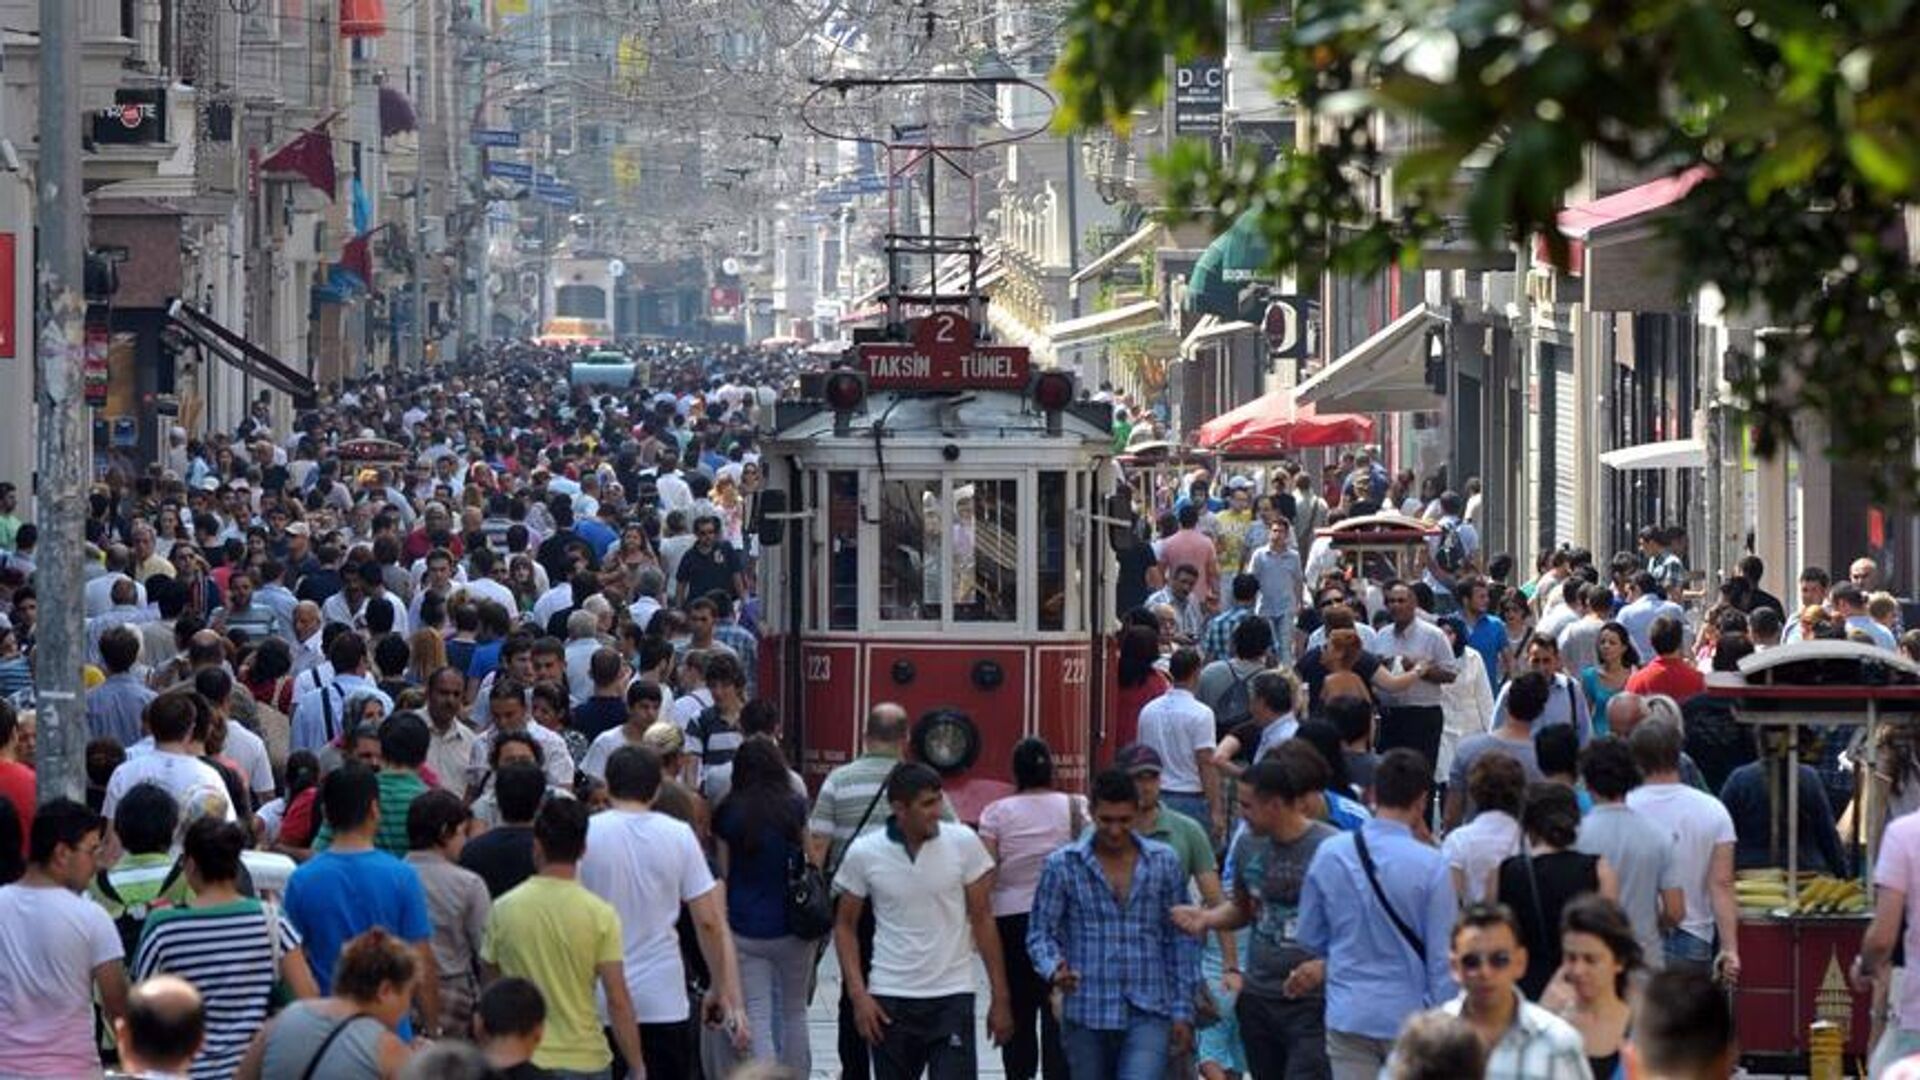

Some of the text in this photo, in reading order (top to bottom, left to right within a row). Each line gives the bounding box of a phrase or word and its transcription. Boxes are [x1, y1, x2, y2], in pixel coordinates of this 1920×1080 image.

[936, 315, 955, 342] 2
[868, 352, 931, 377] TAKSİM
[960, 353, 1018, 377] TÜNEL
